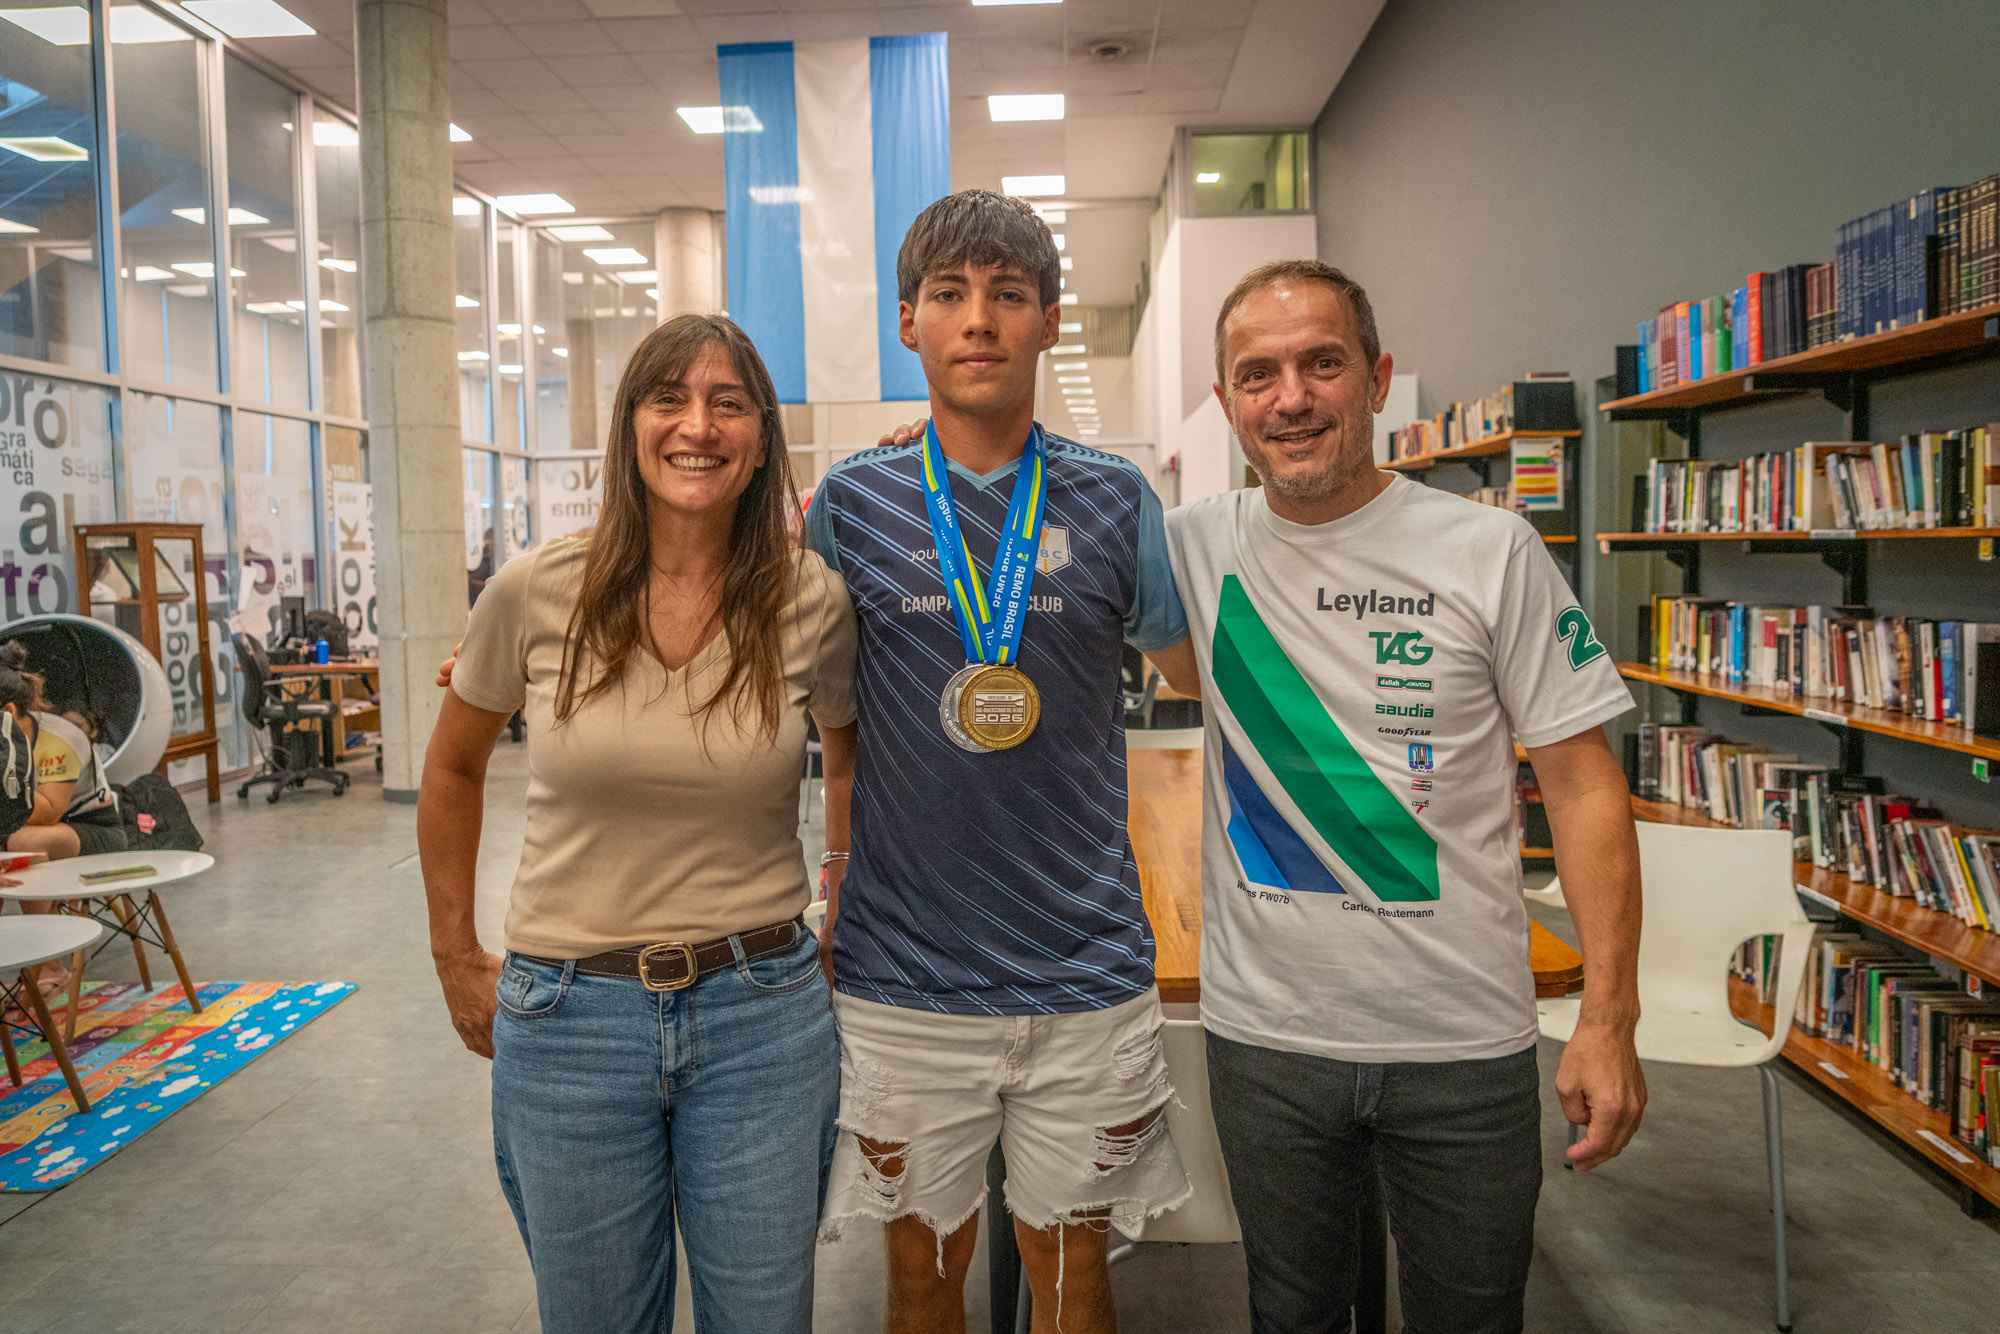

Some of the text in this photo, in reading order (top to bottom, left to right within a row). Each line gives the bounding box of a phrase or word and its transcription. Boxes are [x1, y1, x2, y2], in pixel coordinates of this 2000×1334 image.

[14, 470, 34, 485] ca
[1001, 565, 1026, 640] REMO BRASIL
[1317, 587, 1435, 621] Leyland
[1555, 606, 1608, 673] 2
[1368, 629, 1434, 666] TAG
[1380, 679, 1400, 687] dallah
[975, 713, 1023, 723] 2026
[1375, 703, 1434, 718] saudia
[1378, 726, 1431, 737] GOODYEAR
[1259, 891, 1290, 904] FW07b
[1377, 907, 1434, 918] Reutemann
